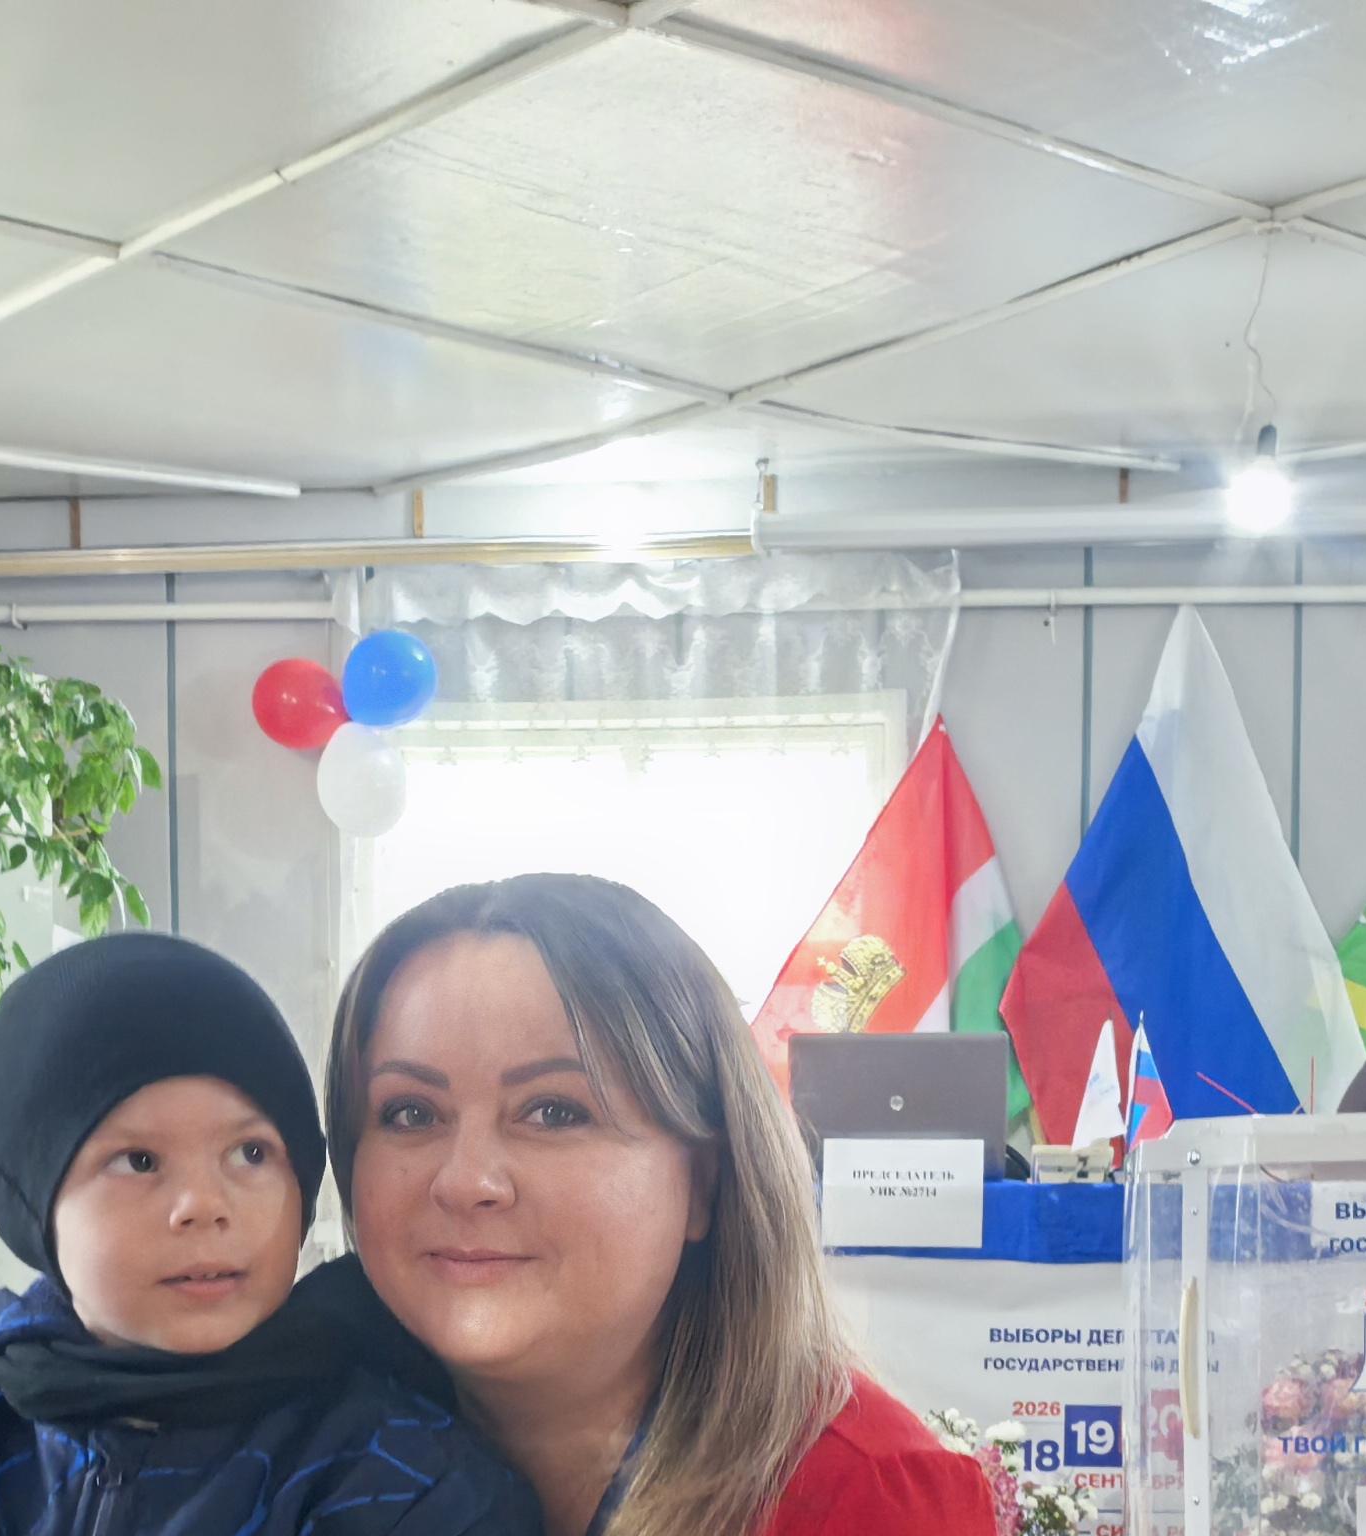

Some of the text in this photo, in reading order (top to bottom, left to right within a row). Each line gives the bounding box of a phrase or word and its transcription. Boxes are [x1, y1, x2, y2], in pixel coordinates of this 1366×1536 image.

[989, 1328, 1081, 1345] ВЫБОРЫ
[1012, 1401, 1061, 1416] 2026
[1021, 1440, 1061, 1472] 18
[1071, 1420, 1115, 1455] 19
[1278, 1430, 1346, 1455] ТВОЙ
